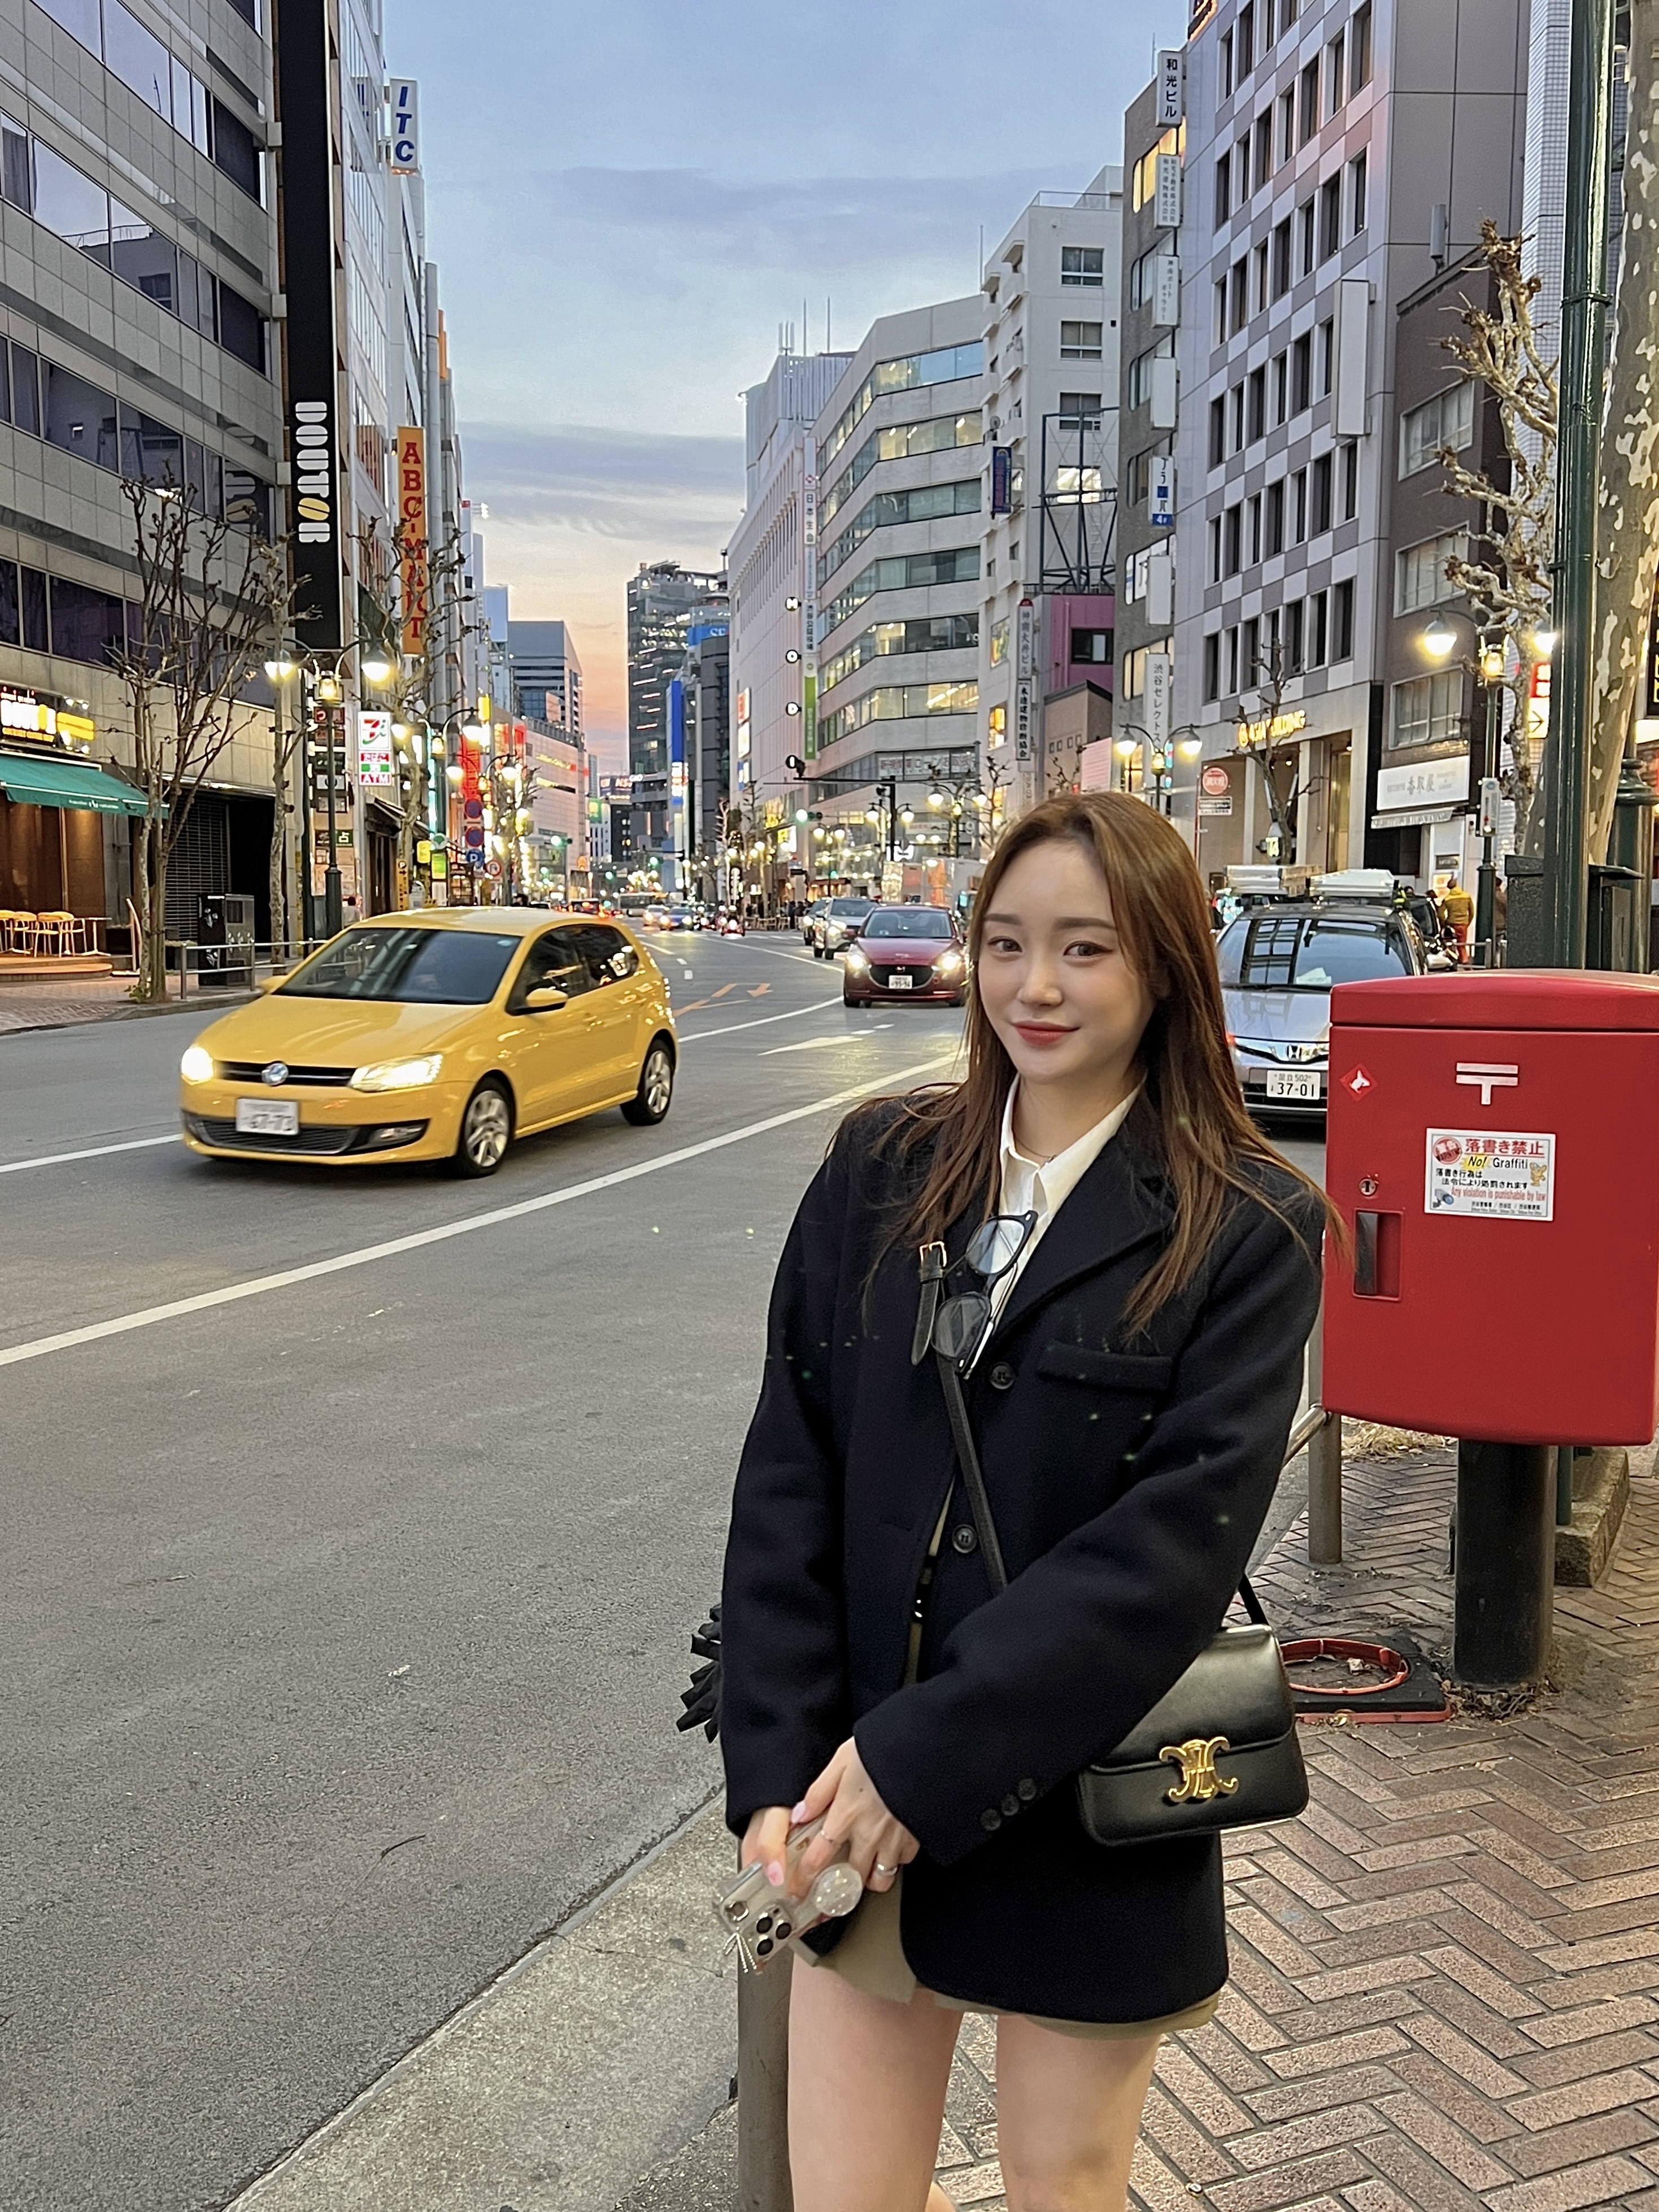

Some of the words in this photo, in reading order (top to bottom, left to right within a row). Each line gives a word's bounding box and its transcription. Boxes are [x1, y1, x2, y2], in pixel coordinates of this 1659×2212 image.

[1165, 58, 1178, 117] 和光ビル
[395, 86, 415, 162] ITC
[295, 402, 330, 543] DOUTOR
[403, 442, 428, 639] ABC-MART
[362, 774, 390, 783] ATM
[1277, 1082, 1314, 1097] 37-01
[1465, 1138, 1544, 1155] 落書き禁止
[1468, 1156, 1487, 1169] No!
[1493, 1157, 1529, 1169] Graffiti
[1436, 1168, 1483, 1178] 落書き行為は
[1451, 1187, 1461, 1198] Any
[1463, 1187, 1487, 1198] violation
[1488, 1188, 1493, 1198] is
[1495, 1189, 1525, 1200] punishable
[1527, 1190, 1534, 1201] by
[1536, 1191, 1546, 1201] law
